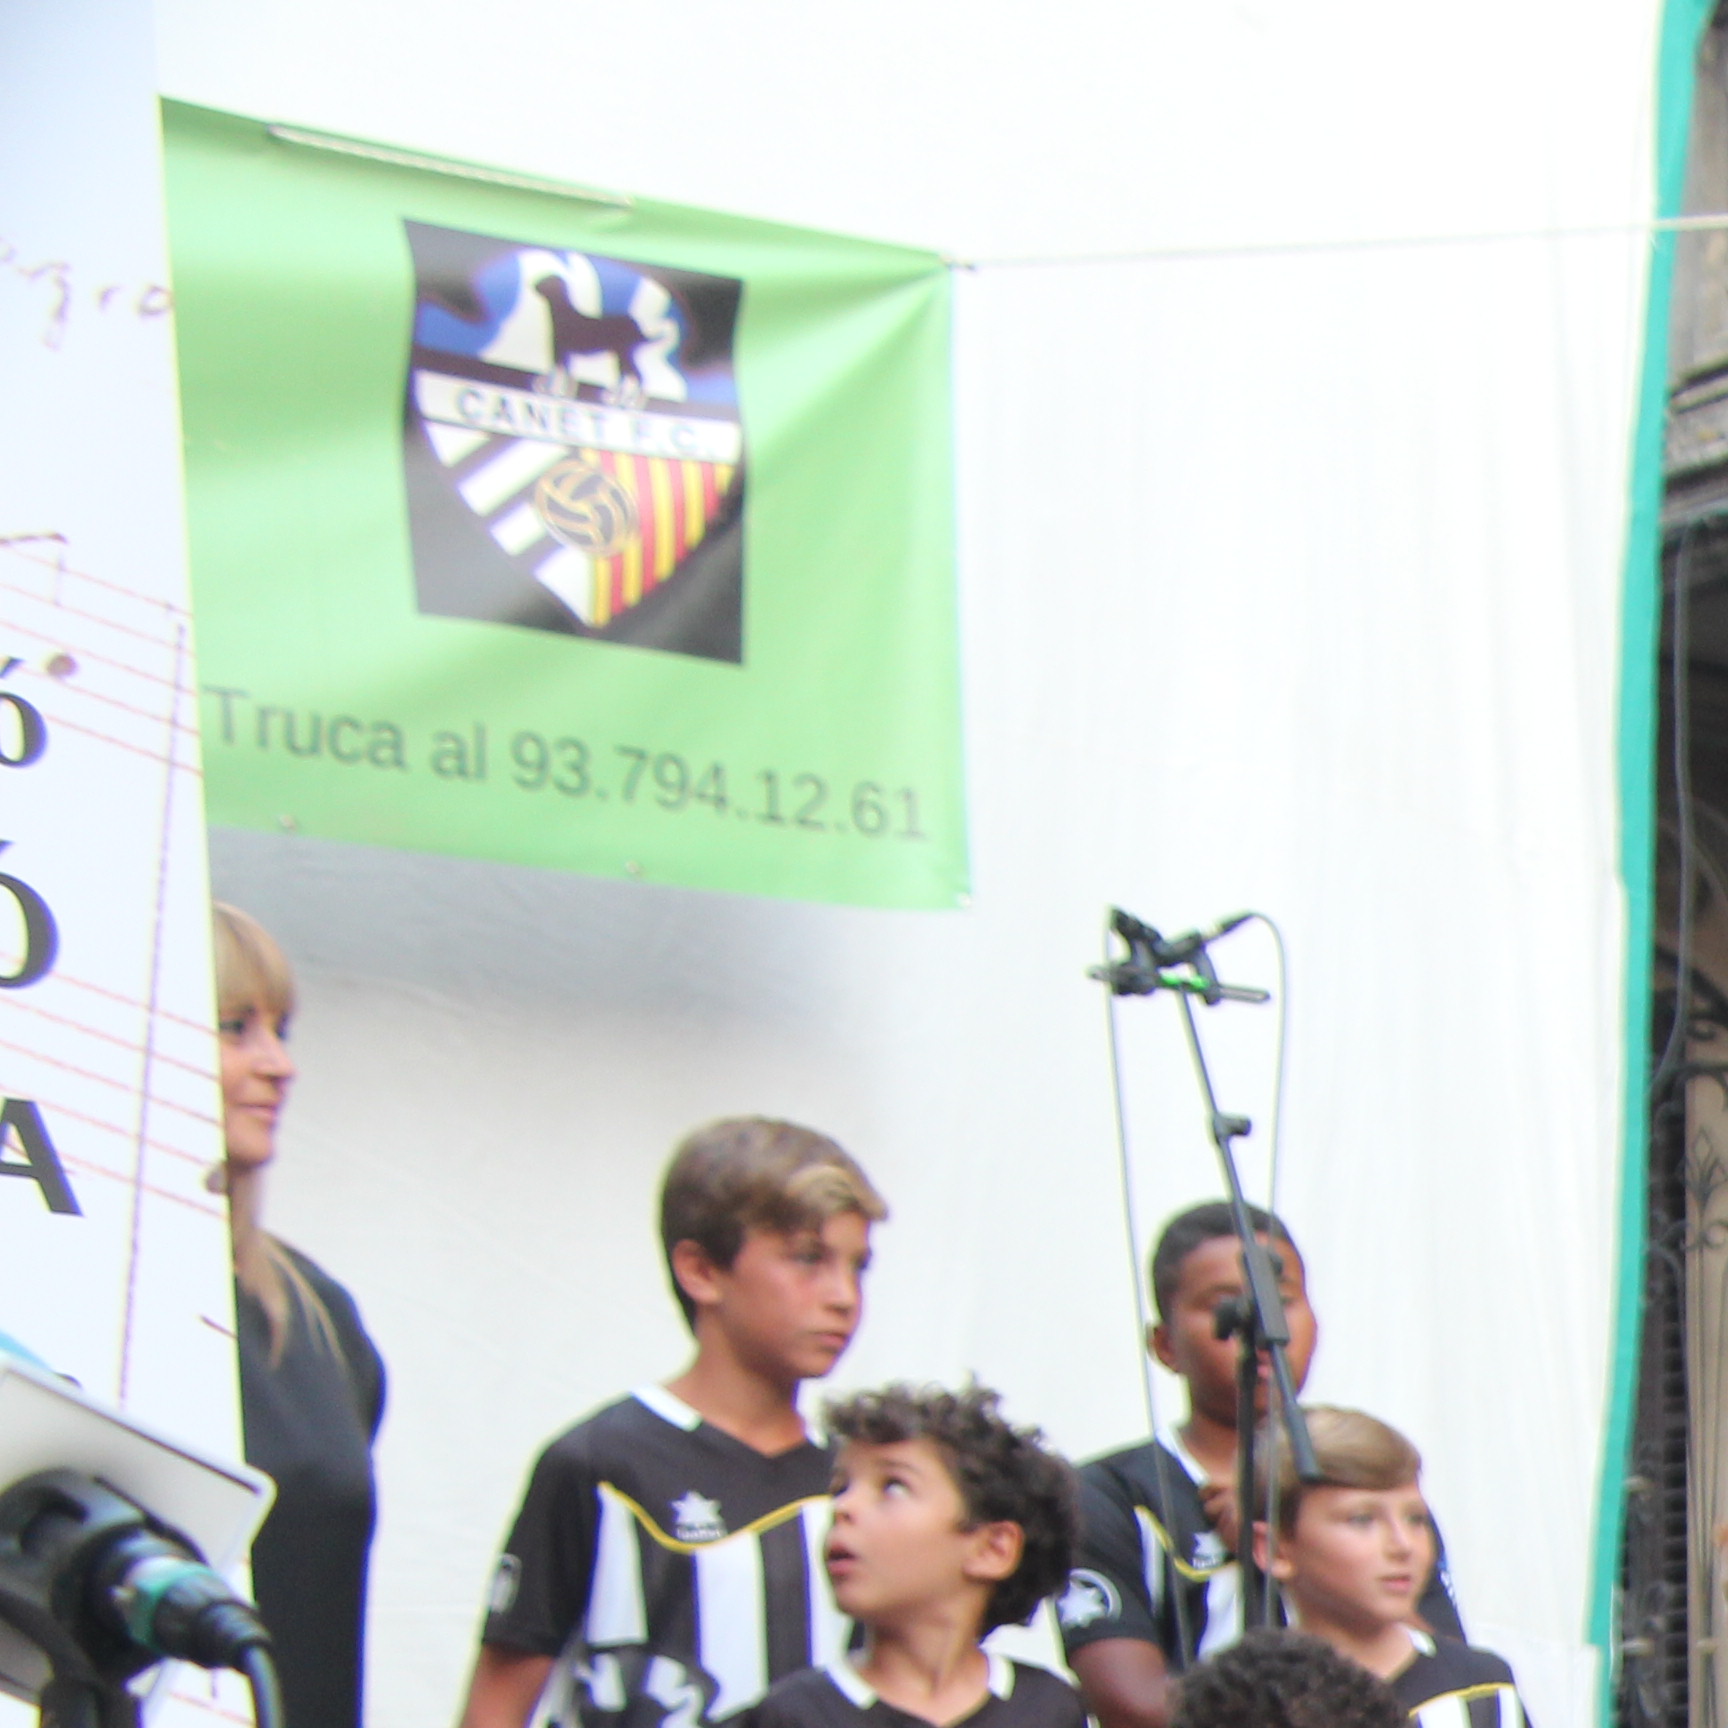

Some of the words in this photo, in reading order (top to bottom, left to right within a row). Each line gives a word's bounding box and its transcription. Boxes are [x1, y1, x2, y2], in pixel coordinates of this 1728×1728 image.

[456, 387, 611, 437] CANET
[203, 683, 410, 773] Truca
[430, 720, 490, 782] al
[511, 729, 929, 841] 93.794.12.61
